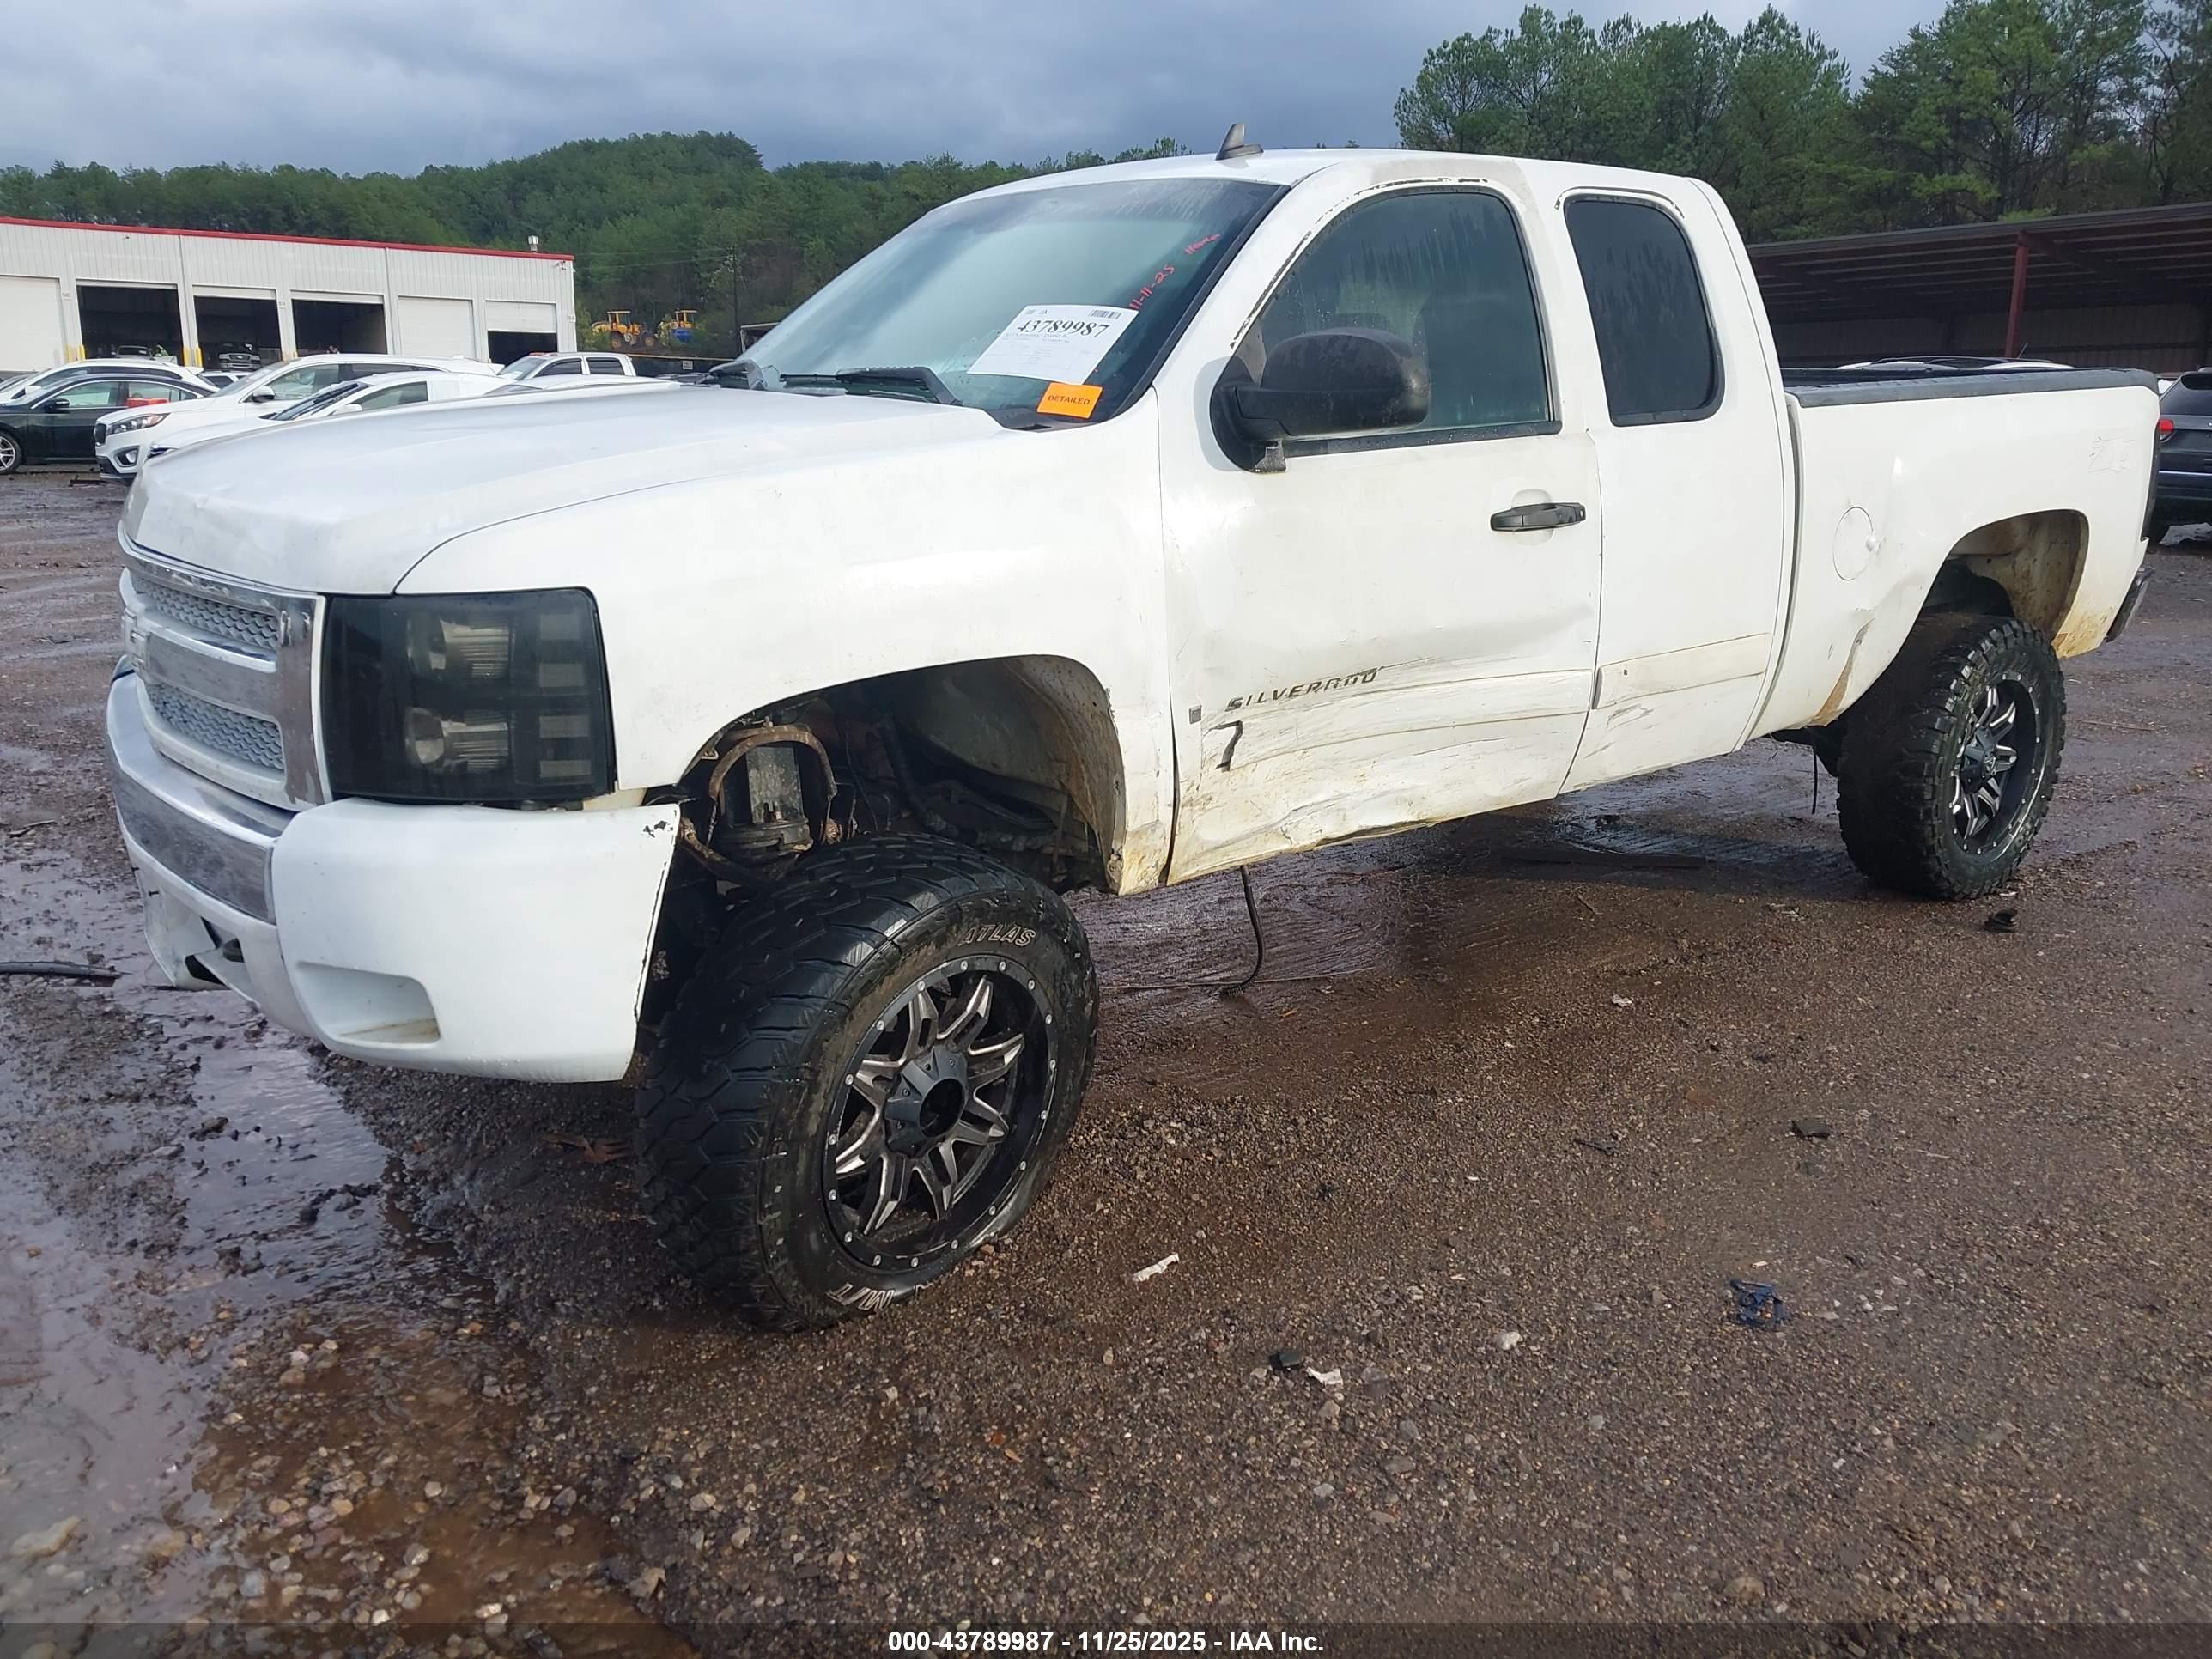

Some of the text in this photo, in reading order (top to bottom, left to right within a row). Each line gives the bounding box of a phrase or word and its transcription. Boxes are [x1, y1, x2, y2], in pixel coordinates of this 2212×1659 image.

[1018, 319, 1110, 337] 43789987
[1048, 395, 1091, 405] DETAILED
[957, 923, 1036, 946] ATLAS
